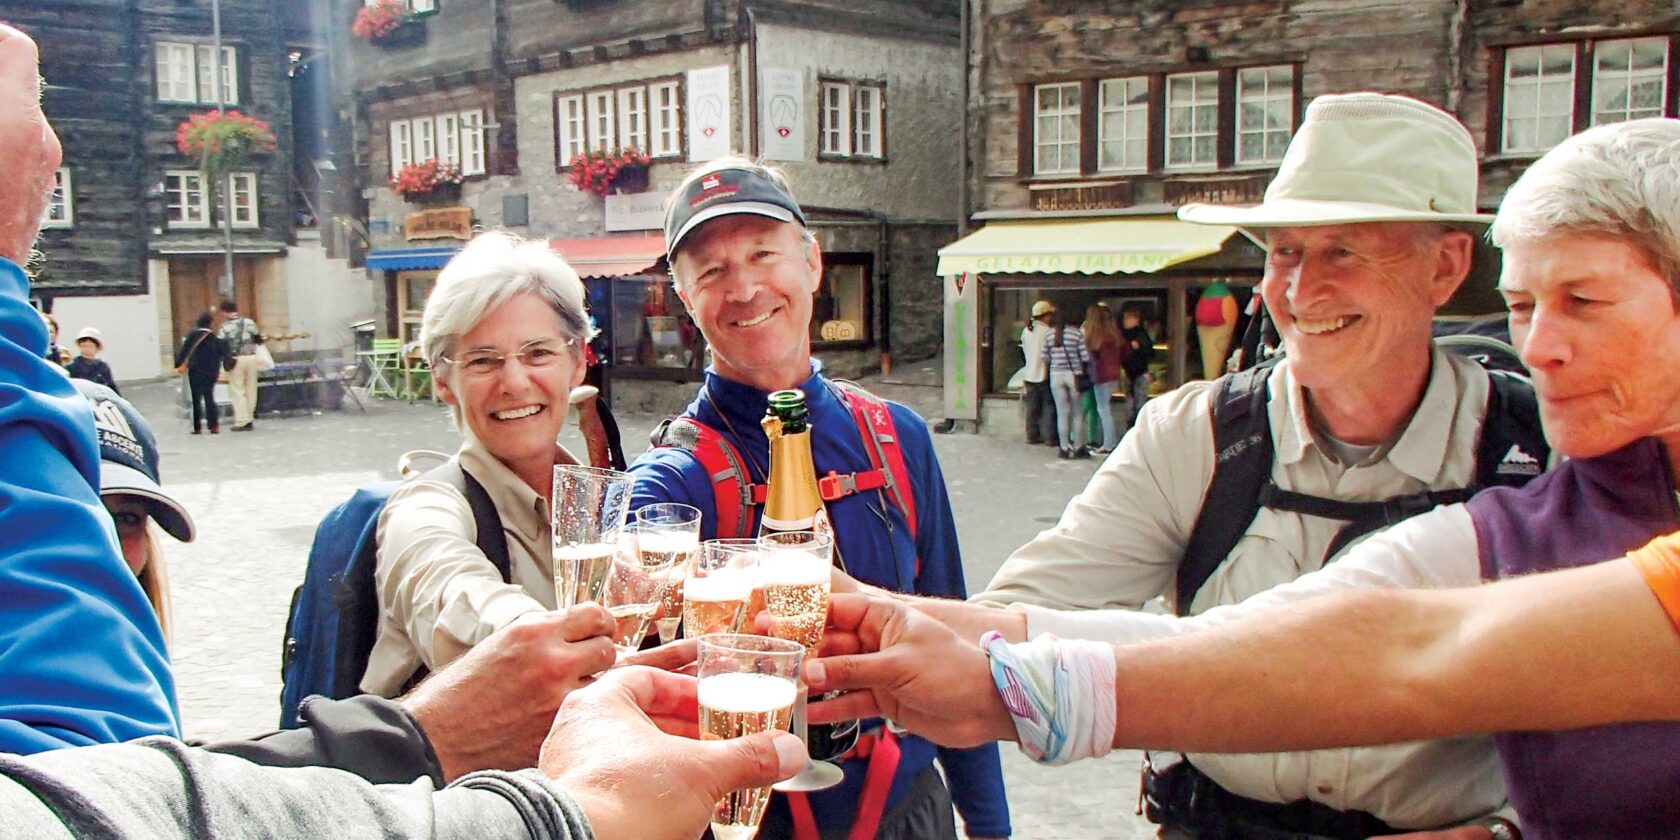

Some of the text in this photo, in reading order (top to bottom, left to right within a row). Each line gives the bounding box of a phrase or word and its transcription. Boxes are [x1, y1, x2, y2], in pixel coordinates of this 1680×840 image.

[976, 253, 1171, 270] GELATO ITALIANO
[103, 430, 143, 458] ASCENTS
